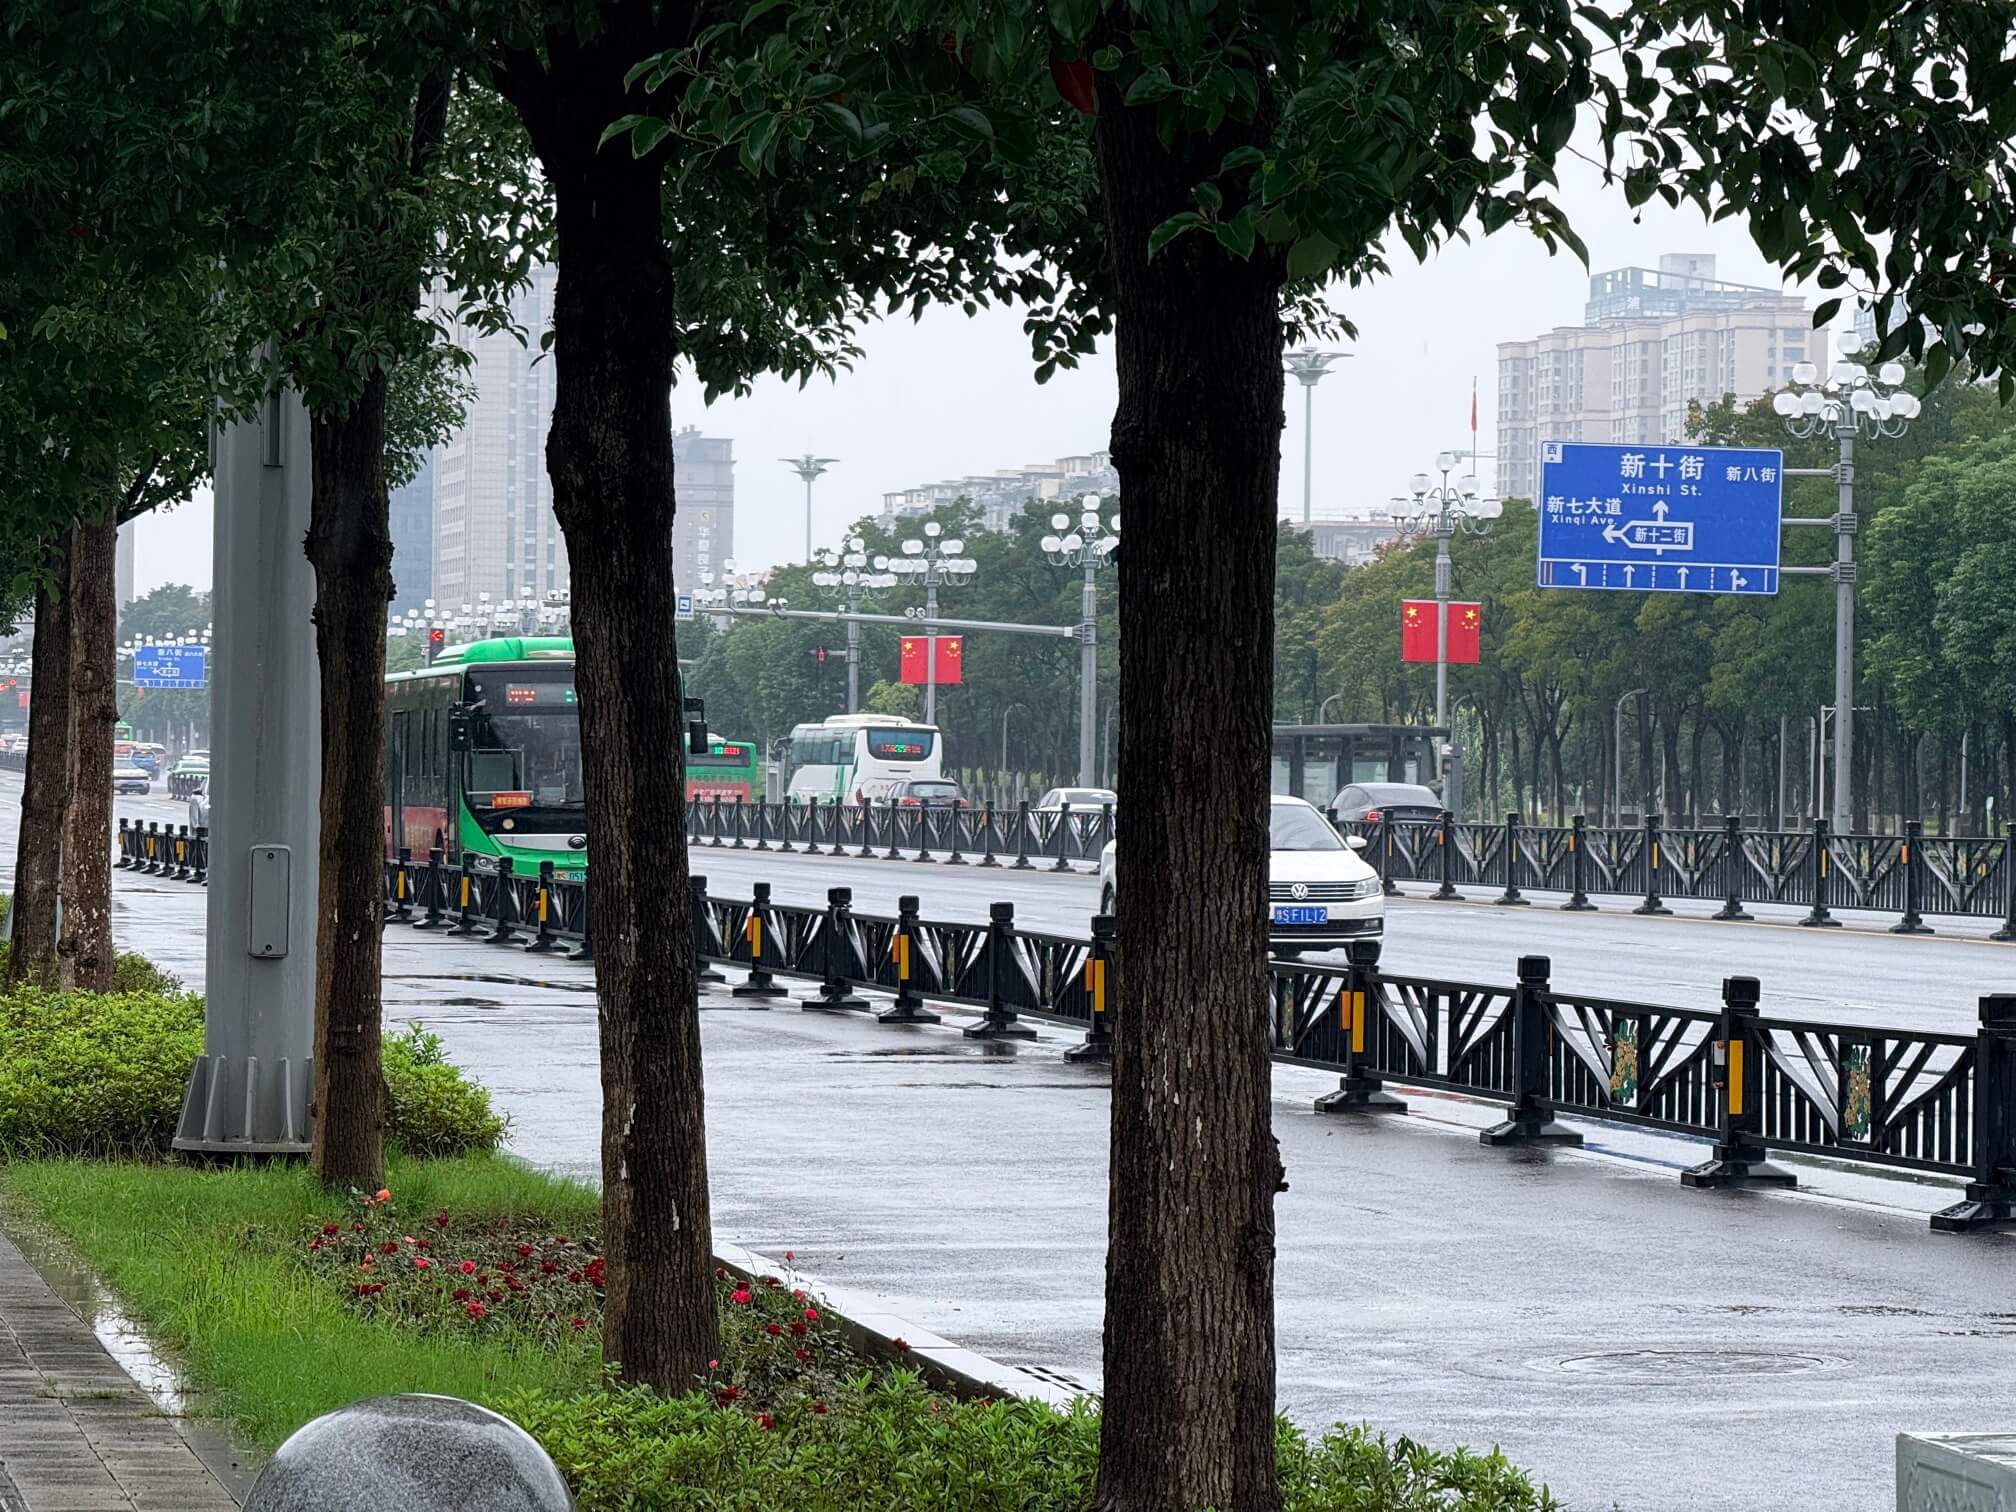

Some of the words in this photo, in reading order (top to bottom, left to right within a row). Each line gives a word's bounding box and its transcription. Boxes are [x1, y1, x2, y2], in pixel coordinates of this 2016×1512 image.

[1621, 452, 1704, 480] 新十街
[1726, 466, 1776, 483] 新八街
[1621, 482, 1671, 495] Xinshi
[1680, 484, 1702, 496] St.
[1546, 495, 1622, 515] 新七大道
[1551, 514, 1585, 525] Xinqi
[1590, 515, 1617, 526] Ave.
[1635, 527, 1686, 544] 新十二街
